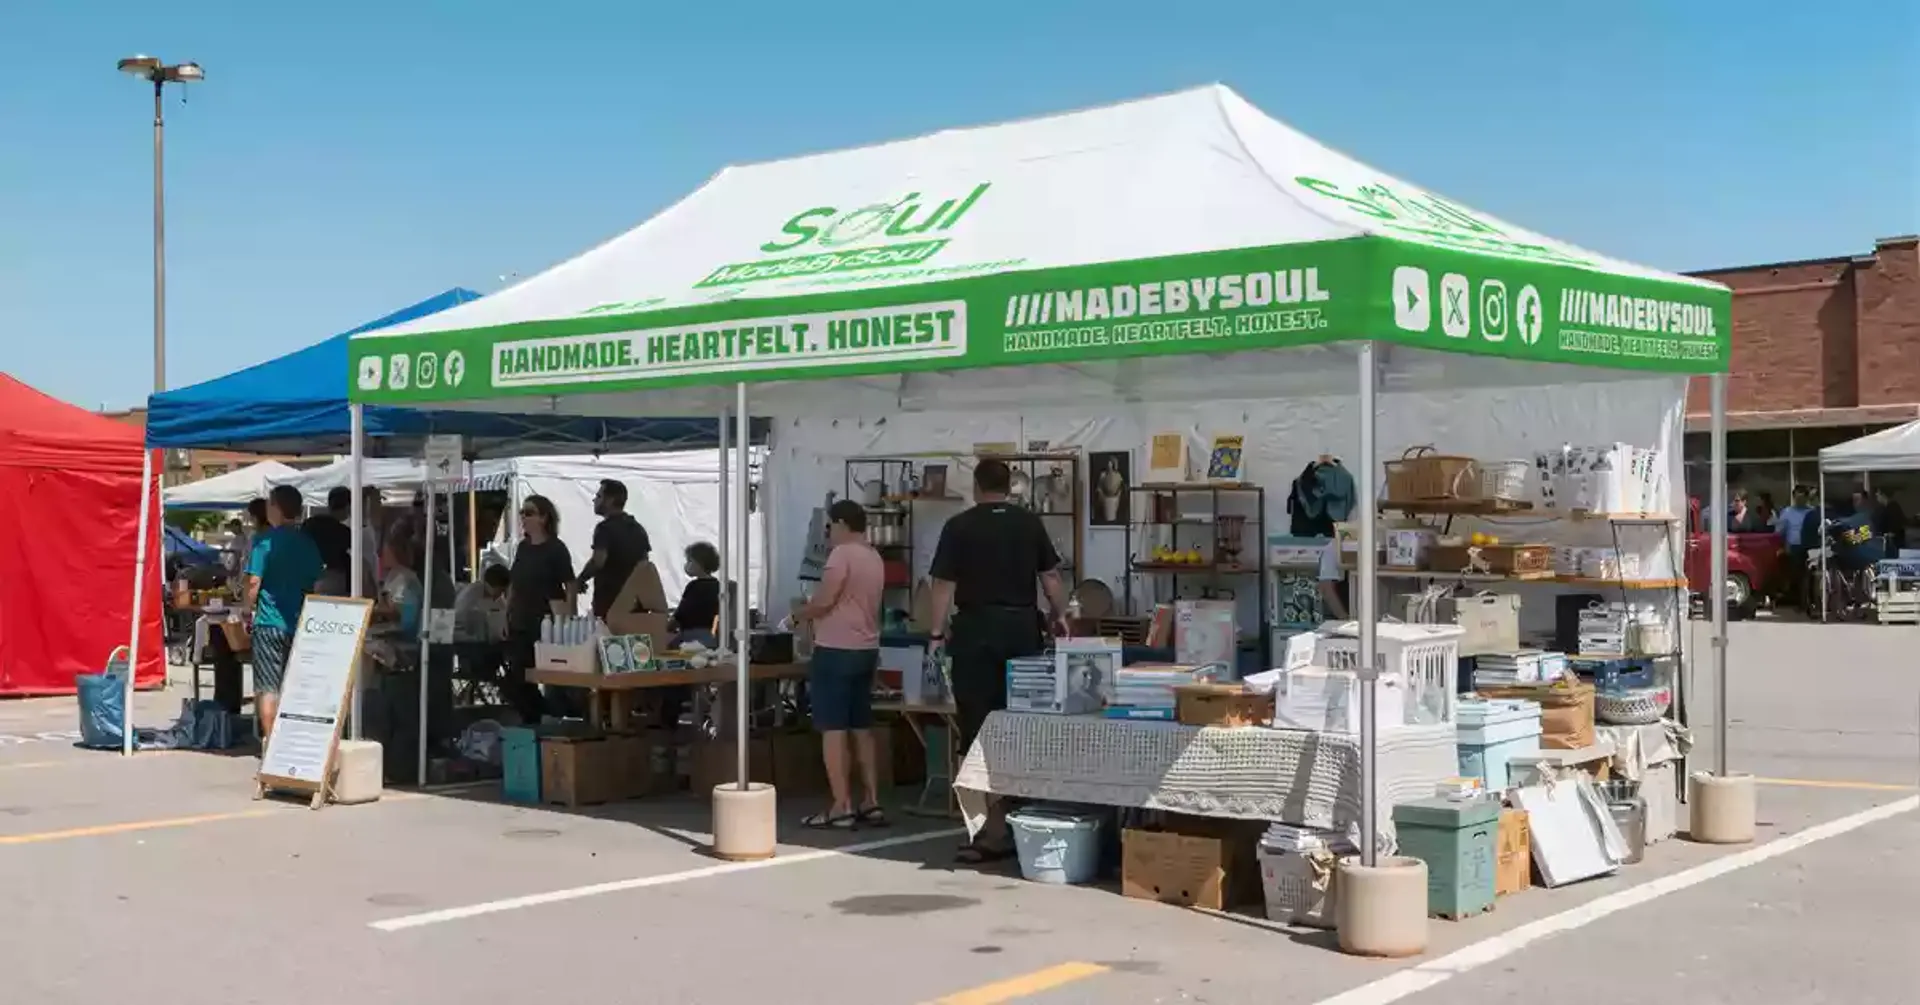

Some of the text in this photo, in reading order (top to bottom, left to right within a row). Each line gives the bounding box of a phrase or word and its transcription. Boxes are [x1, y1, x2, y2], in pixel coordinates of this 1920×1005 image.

[500, 310, 955, 375] HANDMADE. HEARTFELT. HONEST
[1004, 309, 1328, 353] HANDMADE. HEARTFELT. HONEST.
